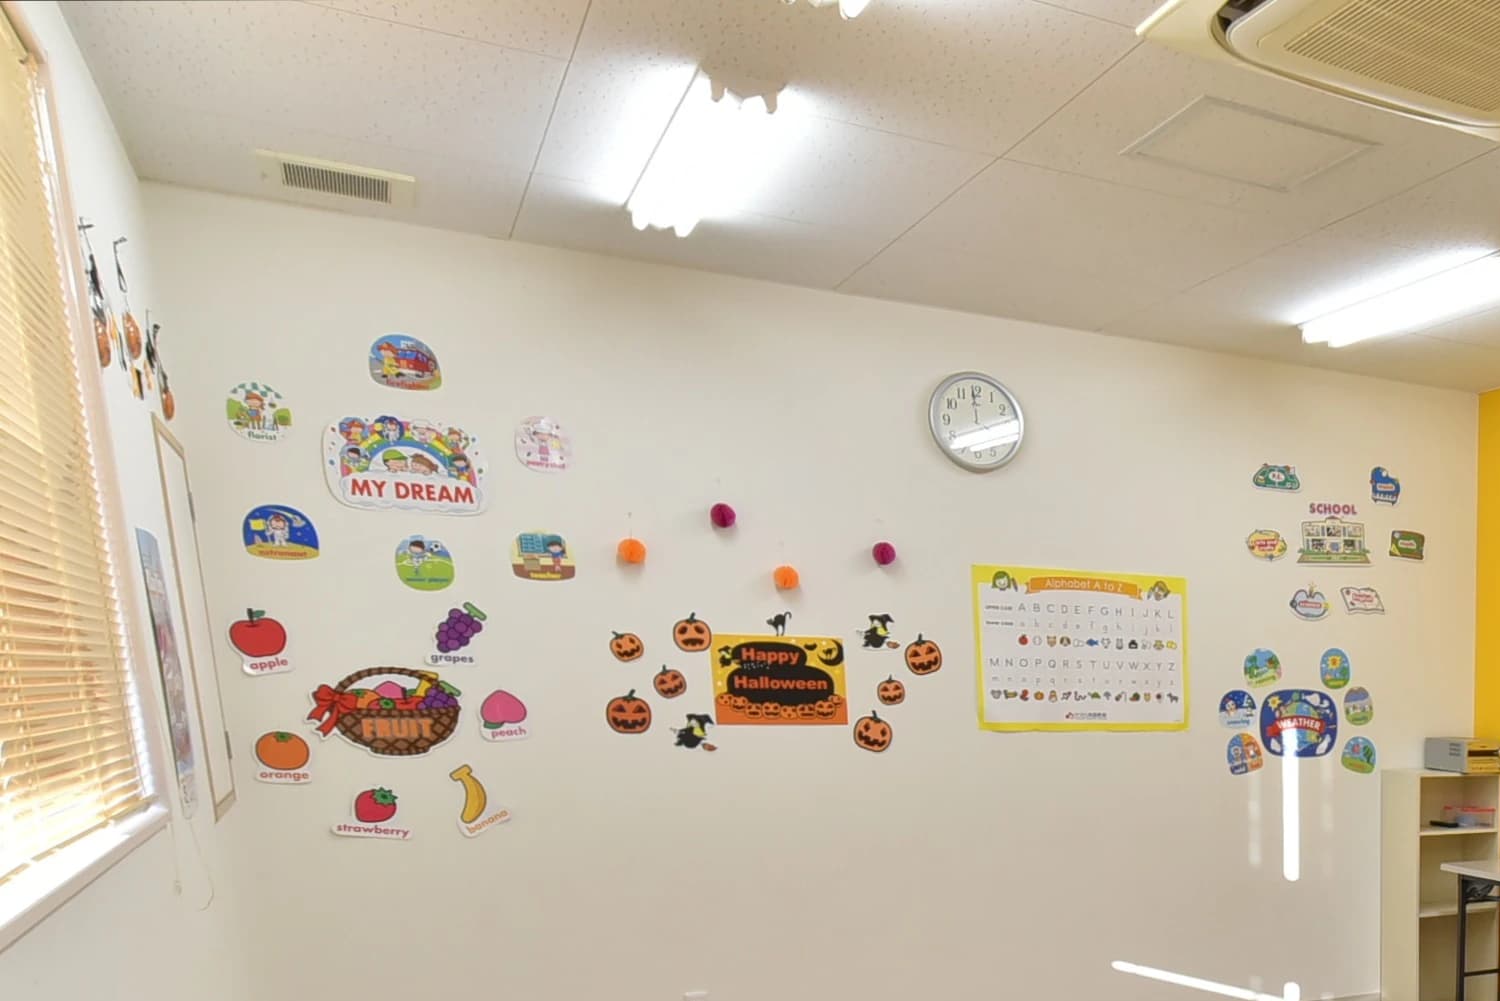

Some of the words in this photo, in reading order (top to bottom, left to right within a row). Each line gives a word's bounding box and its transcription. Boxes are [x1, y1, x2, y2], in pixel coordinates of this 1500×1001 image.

[957, 387, 966, 400] 11
[946, 398, 957, 410] 10
[998, 404, 1006, 416] 2
[942, 413, 951, 425] 9
[351, 478, 387, 498] MY
[394, 482, 475, 506] DREAM
[1309, 503, 1358, 515] SCHOOL
[1045, 579, 1091, 590] Alphabet
[431, 654, 474, 664] grapes
[741, 647, 800, 665] Happy
[250, 657, 289, 672] apple
[733, 675, 828, 690] Halloween
[361, 718, 434, 738] FRUIT
[1277, 718, 1321, 731] WEATHER
[491, 727, 527, 740] peach
[259, 770, 309, 781] orange
[467, 809, 508, 834] banana
[336, 823, 410, 838] strawberry
